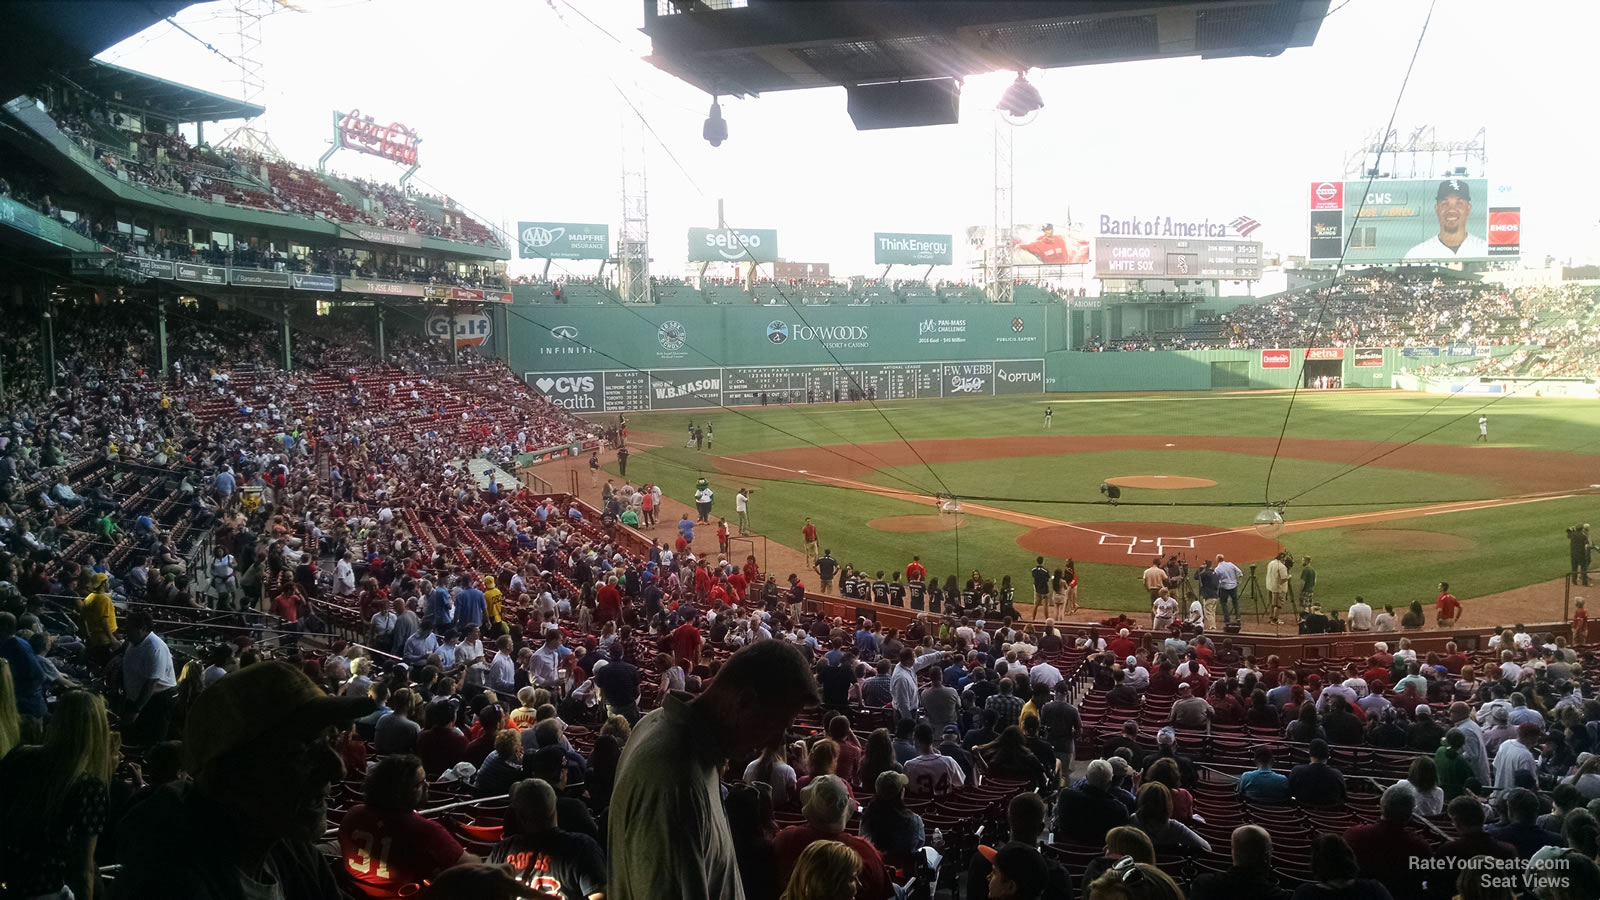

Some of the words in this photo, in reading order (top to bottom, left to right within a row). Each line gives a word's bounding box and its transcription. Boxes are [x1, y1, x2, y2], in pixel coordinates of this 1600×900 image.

[342, 108, 419, 166] Coca-Cola
[1366, 193, 1392, 204] CWS
[1100, 214, 1142, 235] Bank
[1144, 215, 1161, 236] of
[1162, 216, 1227, 237] America
[1490, 224, 1519, 232] ENEOS
[359, 230, 381, 241] CHICAGO
[381, 232, 396, 243] WHITE
[525, 228, 550, 246] AAA
[568, 234, 606, 242] MAPFRE
[879, 238, 947, 254] ThinkEnergy
[1112, 247, 1150, 258] CHICAGO
[1109, 260, 1135, 271] WHITE
[1137, 260, 1154, 271] SOX
[374, 284, 388, 292] JOSE
[388, 285, 403, 293] ABREU
[430, 318, 487, 335] Gulf
[793, 324, 869, 340] FOXWOODS
[540, 346, 593, 354] INFINITI
[1310, 349, 1338, 358] aetna
[944, 365, 961, 376] F.W.
[963, 364, 992, 375] WEBB
[1008, 372, 1041, 383] OPTUM
[555, 376, 595, 393] CVS
[348, 828, 393, 880] 31
